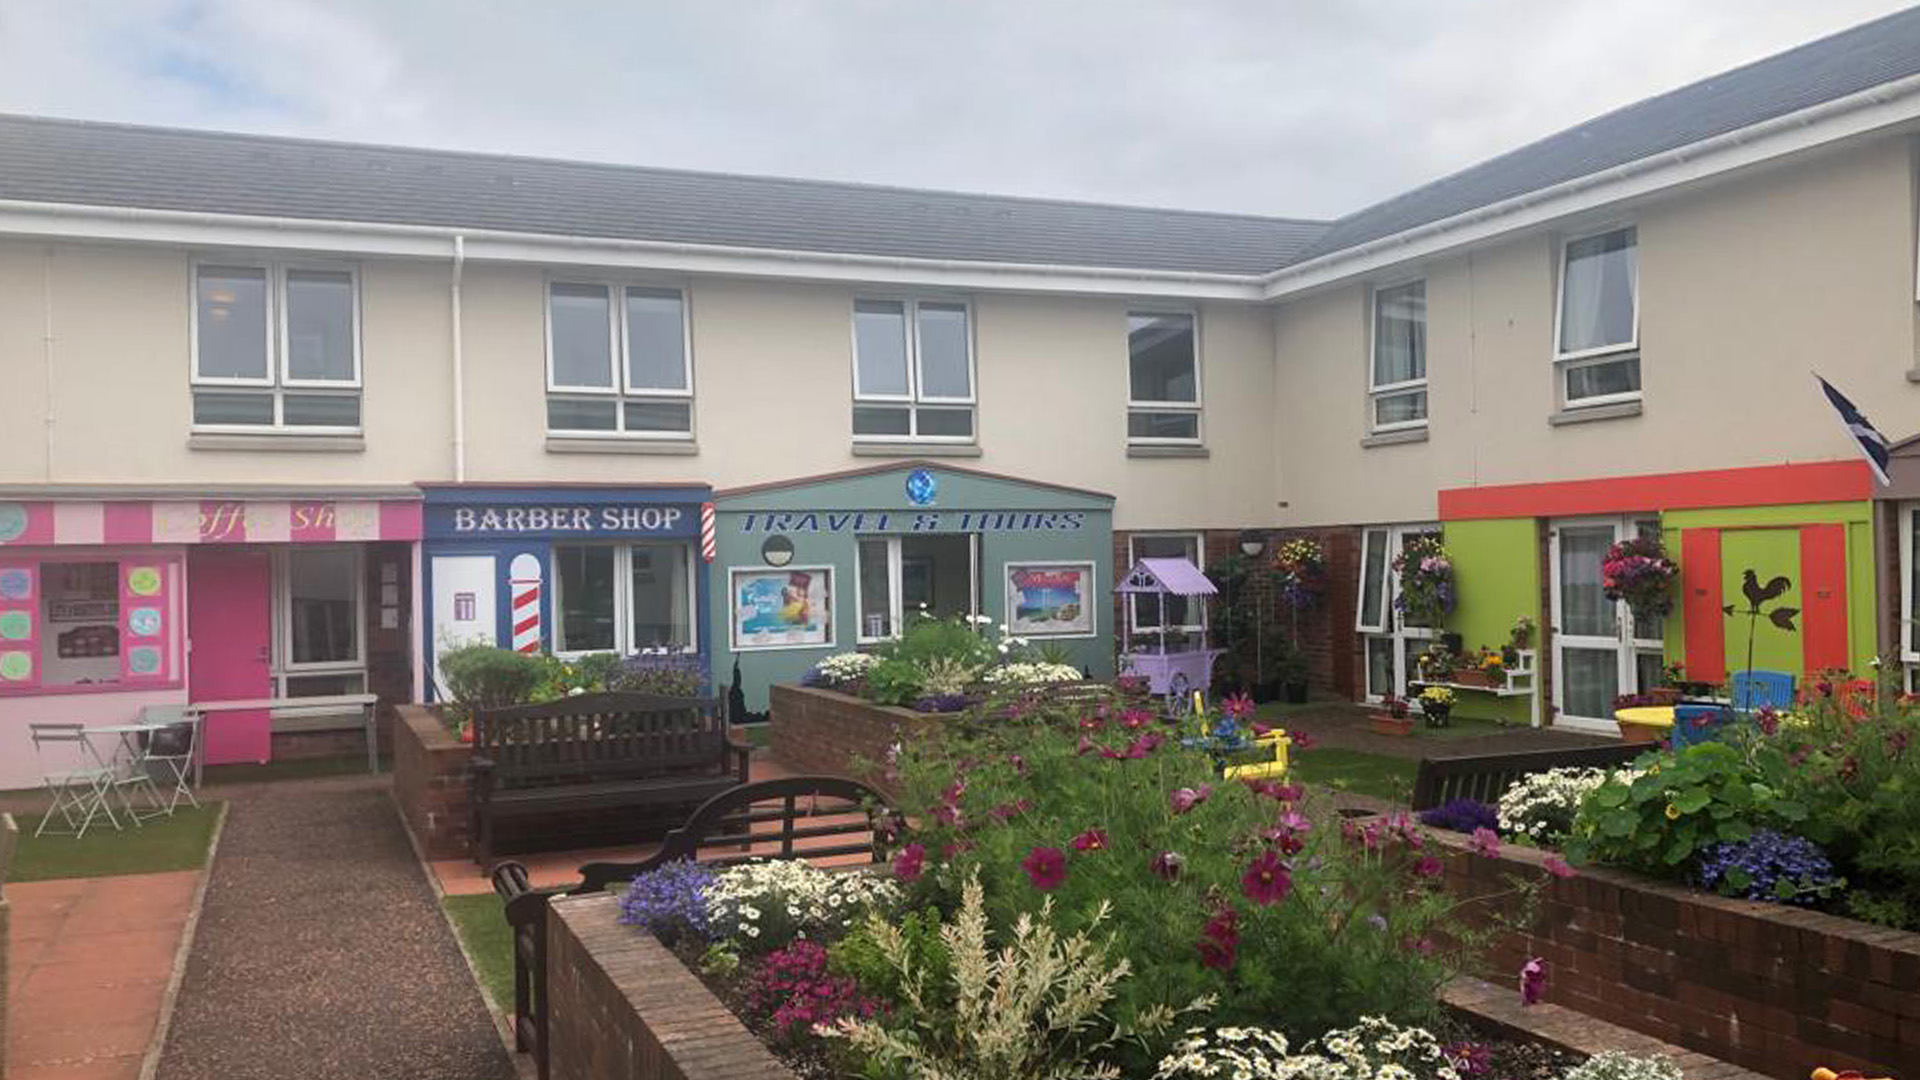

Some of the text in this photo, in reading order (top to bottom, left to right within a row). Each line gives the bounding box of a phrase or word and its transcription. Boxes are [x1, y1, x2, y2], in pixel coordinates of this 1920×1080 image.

[455, 507, 682, 531] BARBER SHOP
[743, 512, 1084, 532] TRAVEL & TOURS
